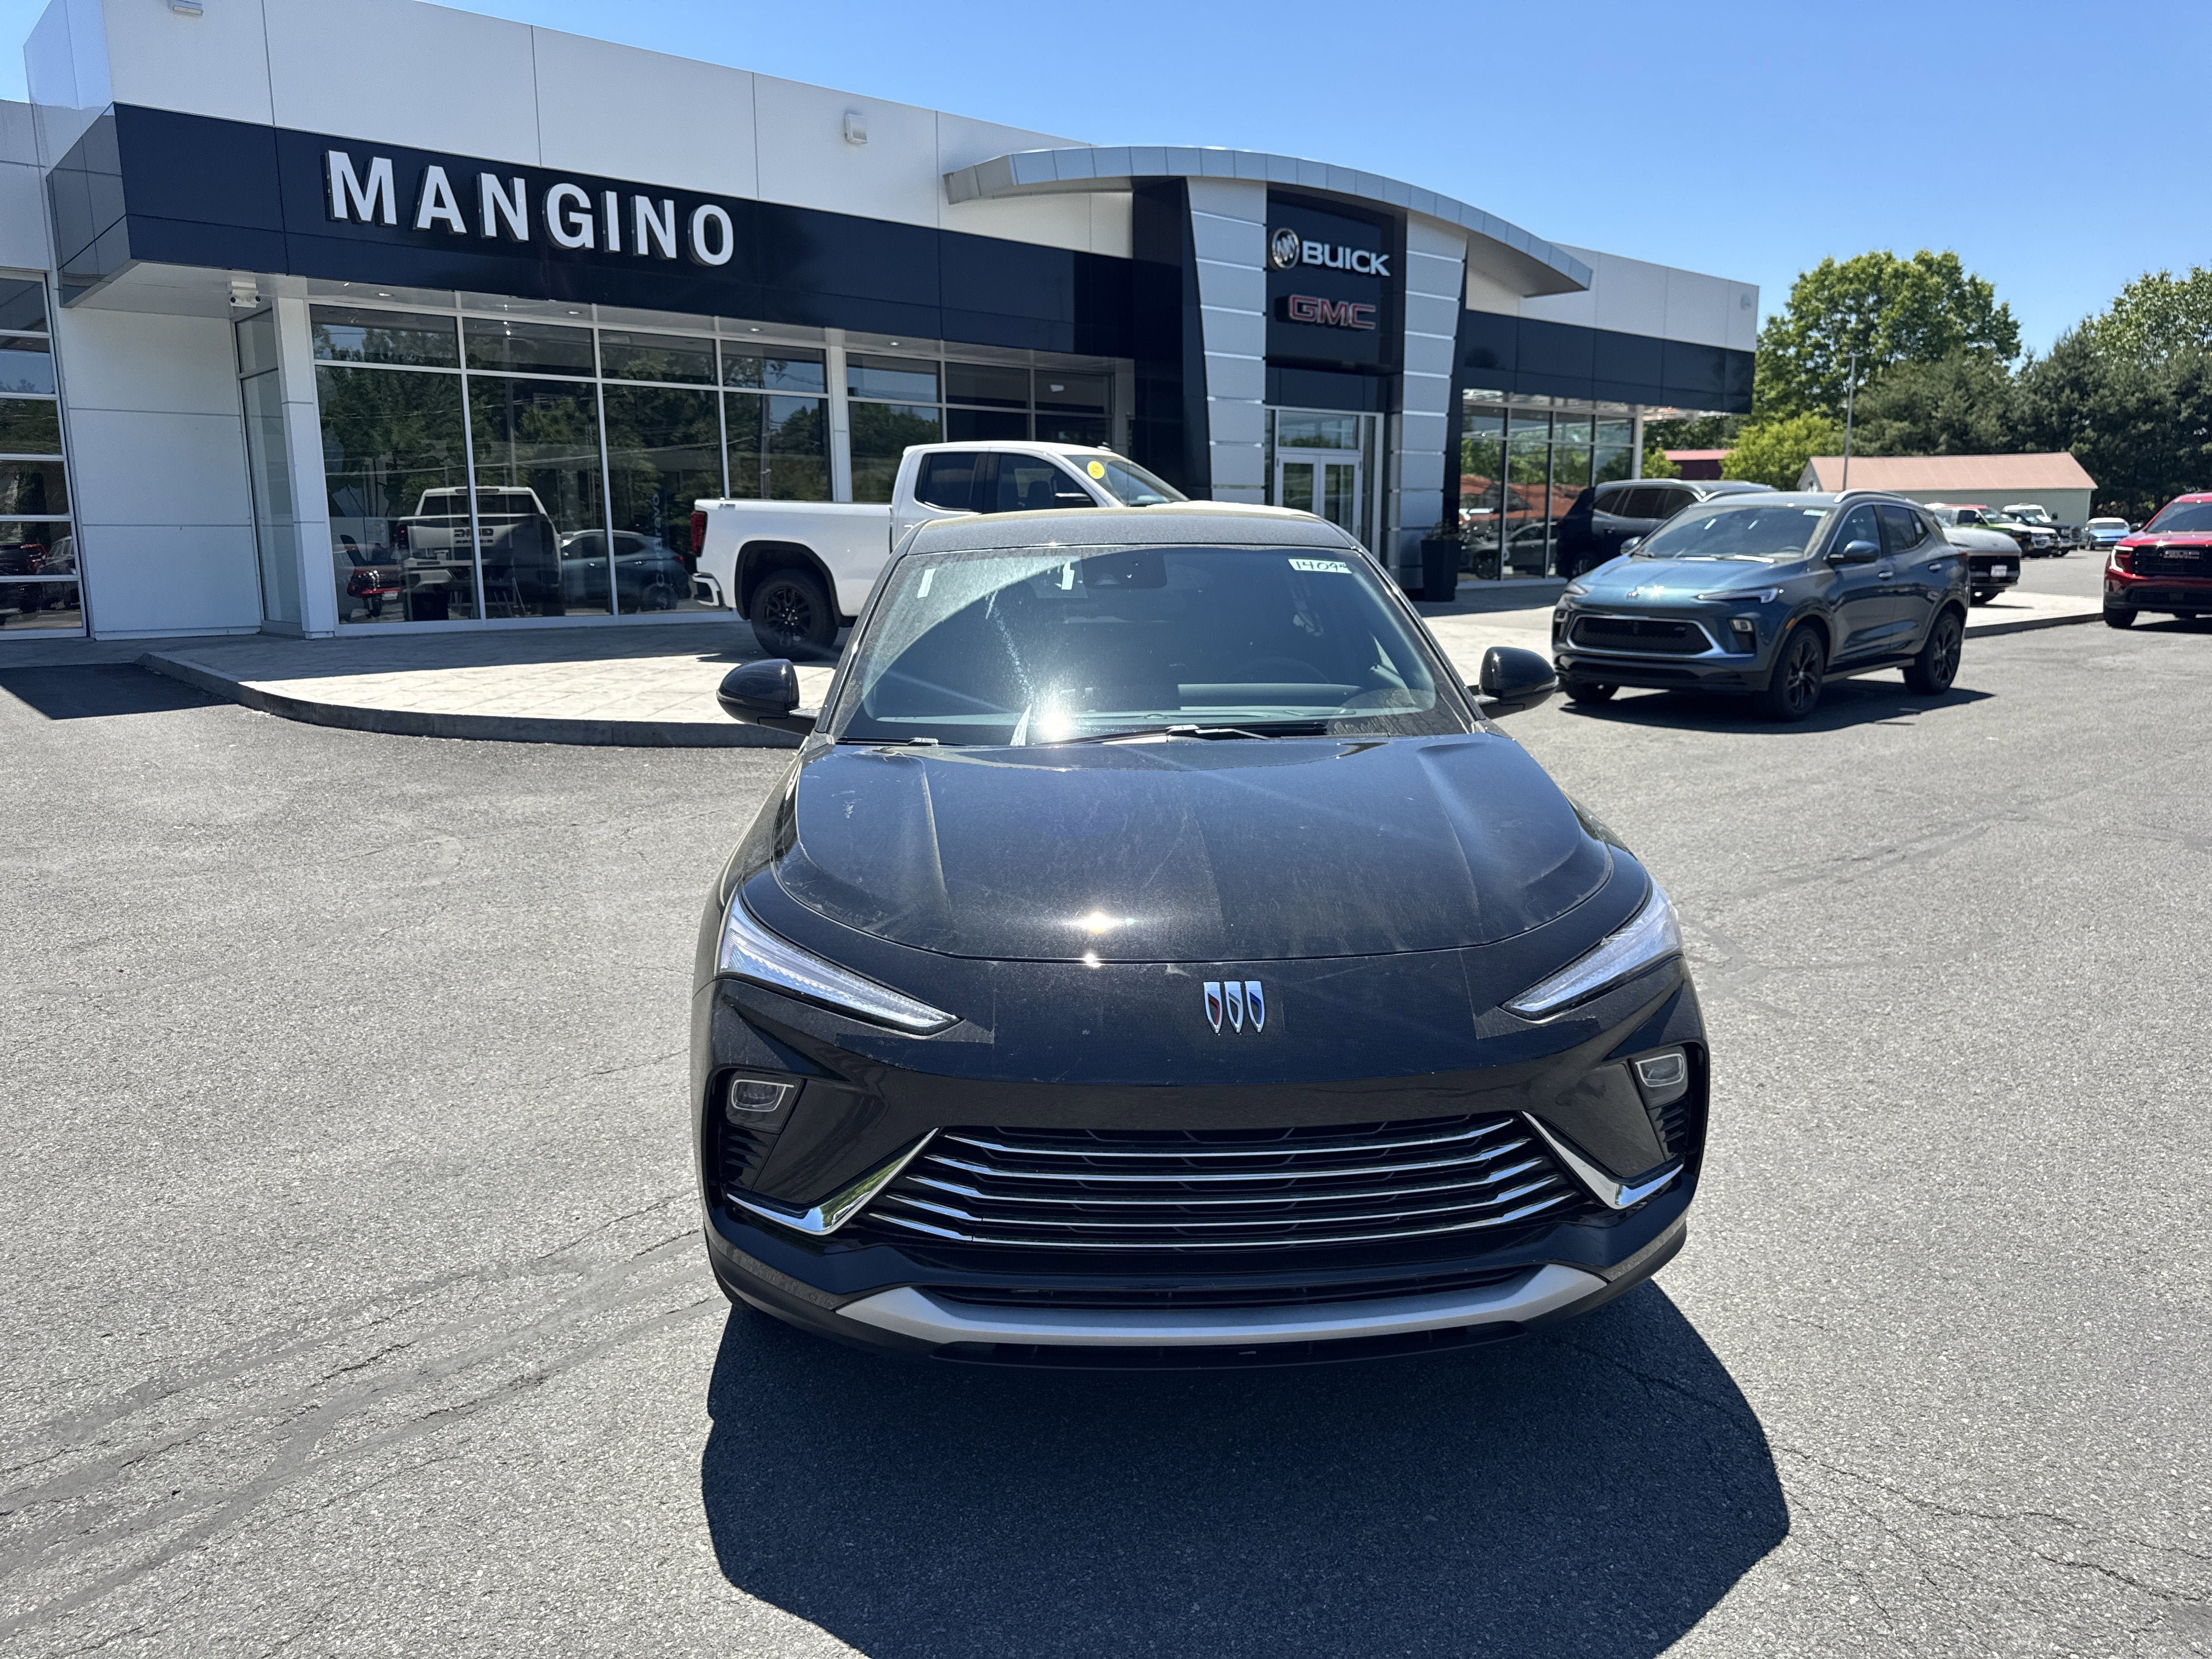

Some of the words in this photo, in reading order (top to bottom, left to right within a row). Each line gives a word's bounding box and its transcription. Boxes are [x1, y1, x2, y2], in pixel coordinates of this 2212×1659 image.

[326, 150, 735, 267] MANGINO
[1302, 240, 1391, 277] BUICK
[1289, 294, 1376, 330] GMC
